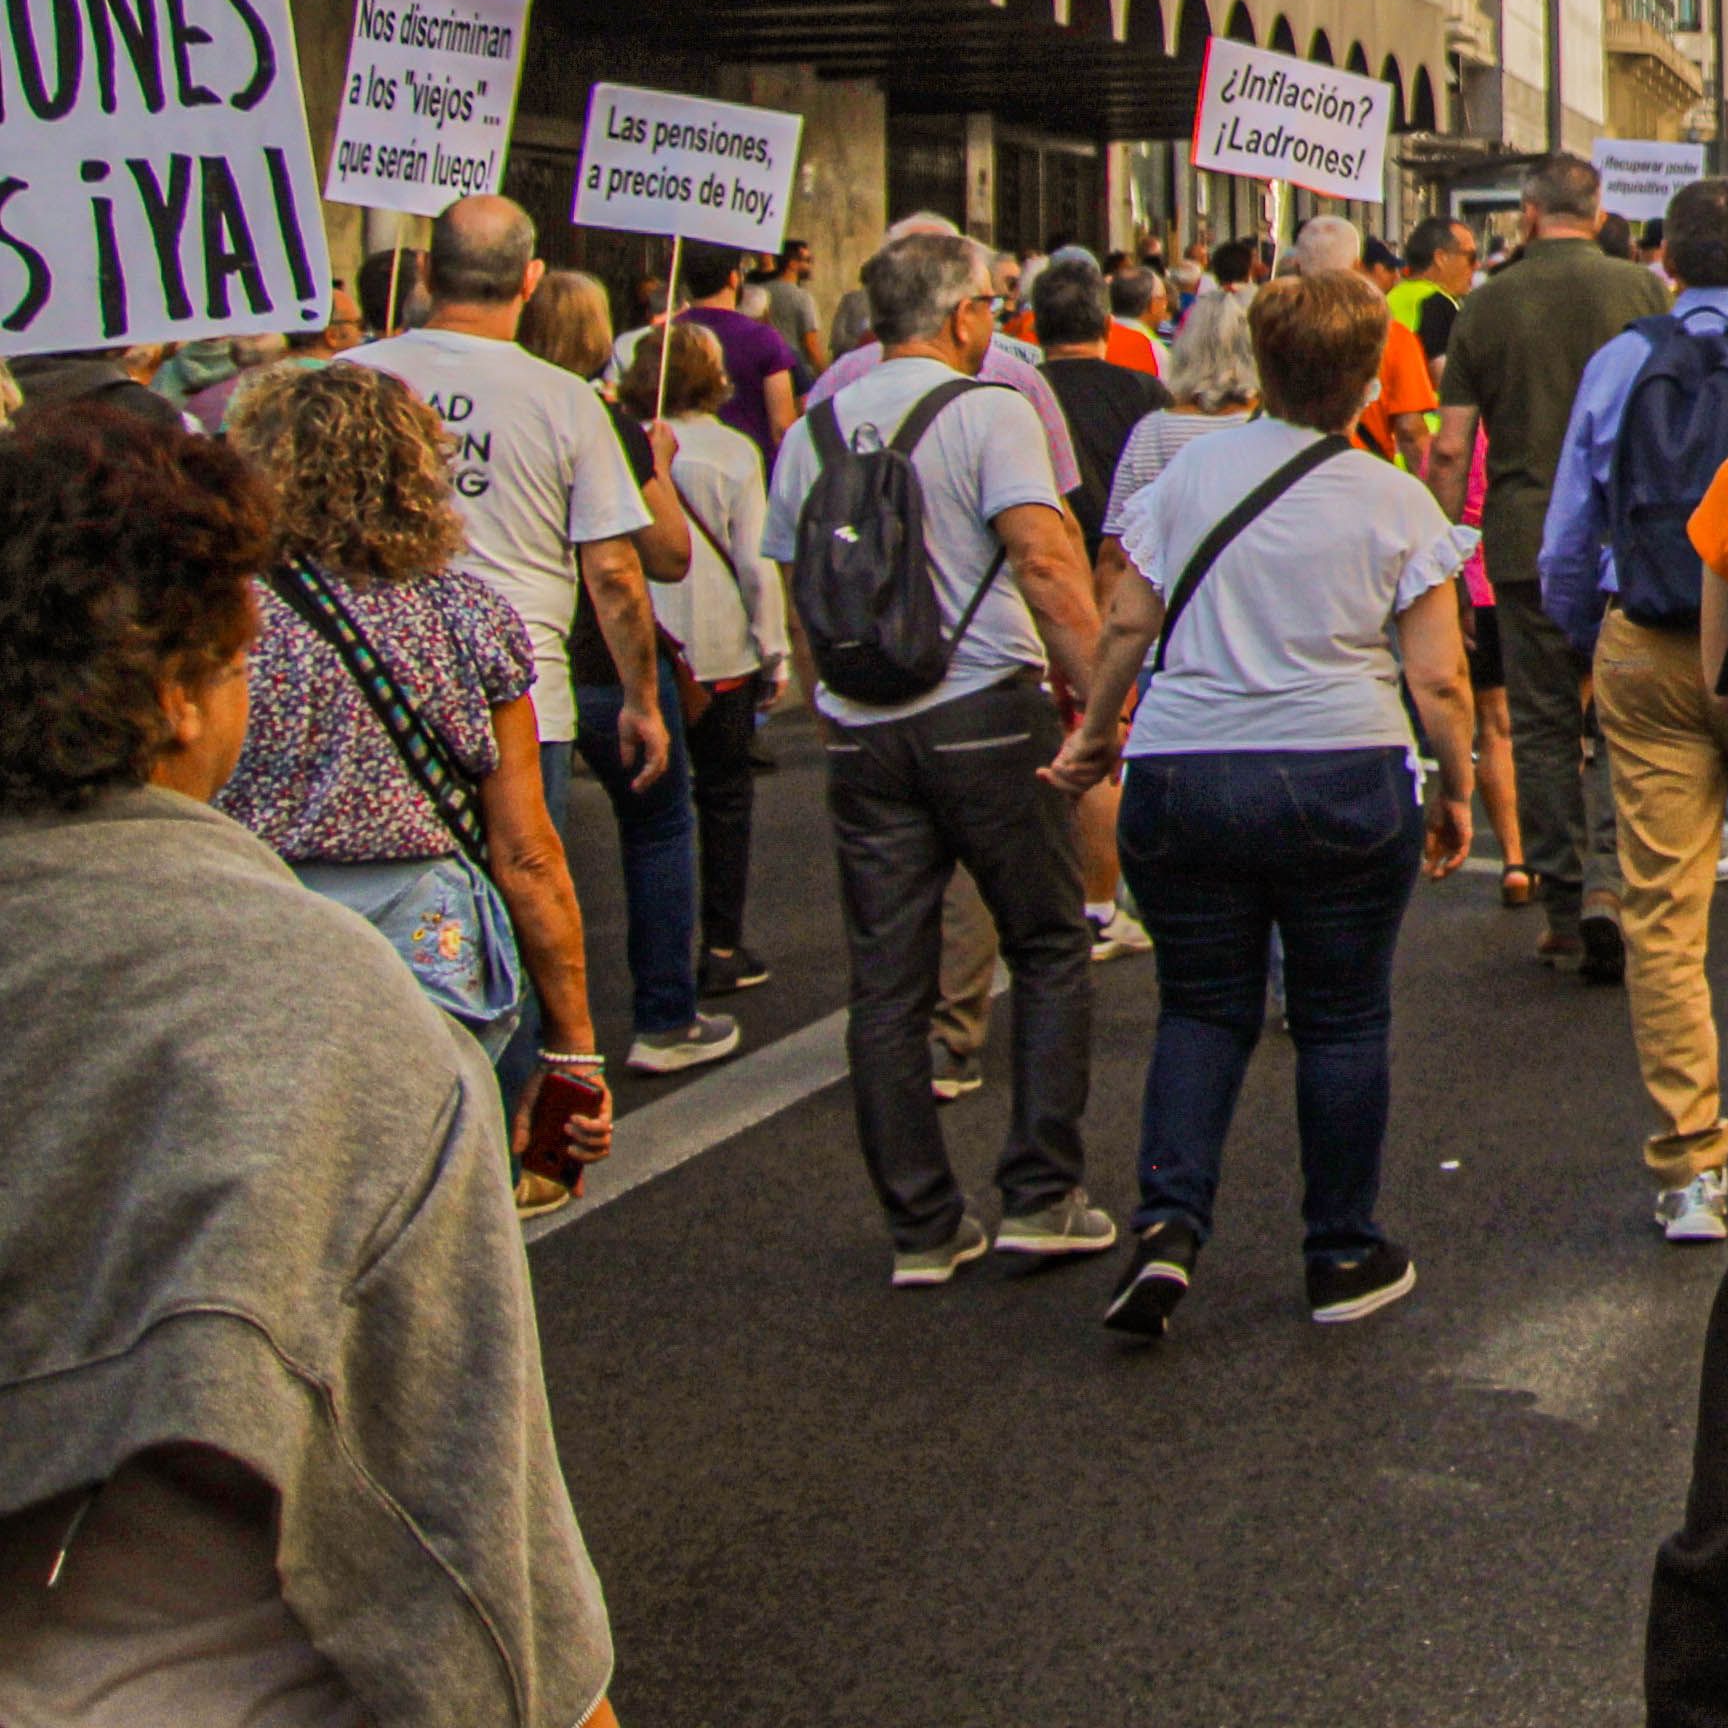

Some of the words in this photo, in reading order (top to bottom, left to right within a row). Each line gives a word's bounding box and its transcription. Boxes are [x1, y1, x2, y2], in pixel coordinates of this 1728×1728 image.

[400, 3, 512, 60] discriminan
[349, 71, 362, 106] a
[366, 65, 397, 110] los
[1220, 64, 1374, 130] ¿Inflación?
[337, 140, 371, 183] que
[375, 139, 428, 184] serán
[431, 143, 495, 198] luego!
[606, 105, 648, 144] Las
[652, 122, 773, 170] pensiones,
[1214, 117, 1367, 181] ¡Ladrones!
[587, 163, 600, 190] a
[606, 165, 692, 201] precios
[699, 172, 725, 209] de
[731, 178, 774, 225] hoy.
[81, 147, 319, 339] ¡YA!
[456, 432, 492, 464] N
